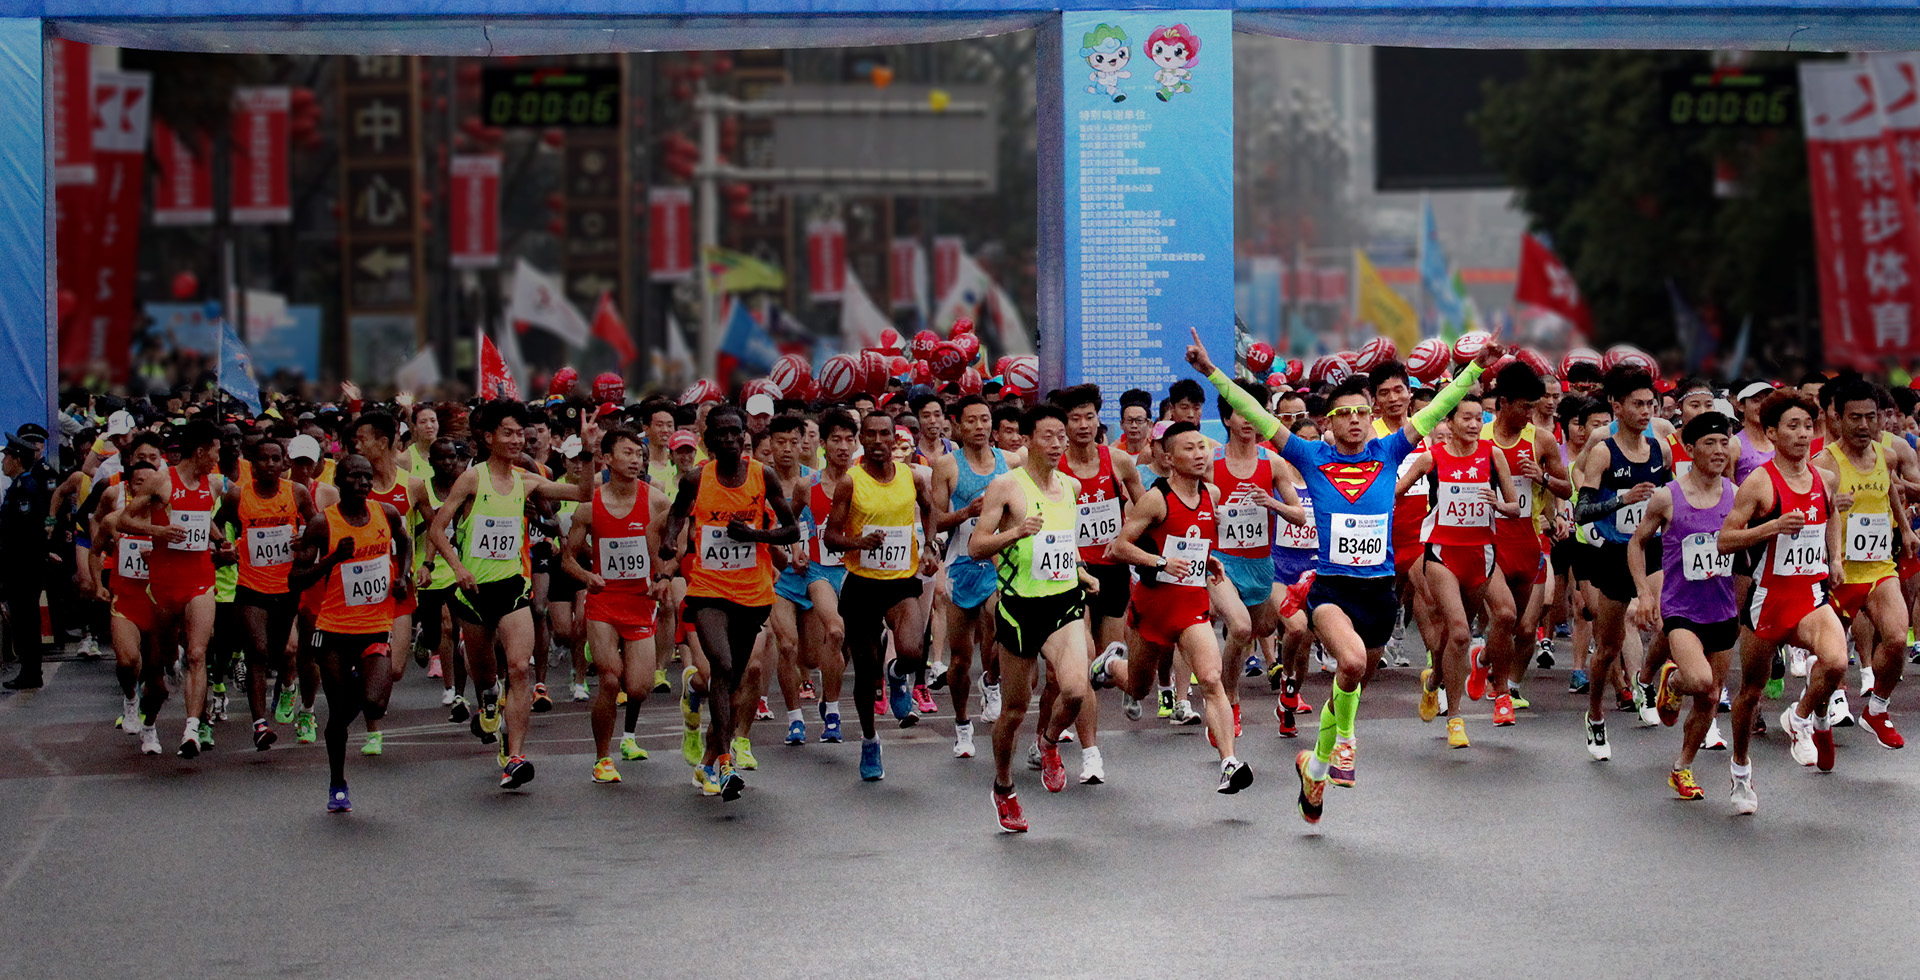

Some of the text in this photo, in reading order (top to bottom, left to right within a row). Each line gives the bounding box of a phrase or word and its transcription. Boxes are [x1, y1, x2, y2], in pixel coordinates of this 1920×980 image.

[931, 350, 961, 375] 3:00
[1446, 501, 1485, 517] A313
[187, 528, 206, 543] 164
[1079, 518, 1116, 539] A105
[1226, 522, 1263, 540] A194
[1283, 523, 1317, 539] A336
[255, 542, 289, 560] A014
[479, 534, 515, 551] A187
[1338, 537, 1382, 554] B3460
[705, 546, 752, 560] A017
[867, 546, 907, 561] A1677
[1692, 552, 1730, 571] A148
[1783, 547, 1821, 566] A104
[607, 555, 645, 571] A199
[352, 575, 388, 598] A003
